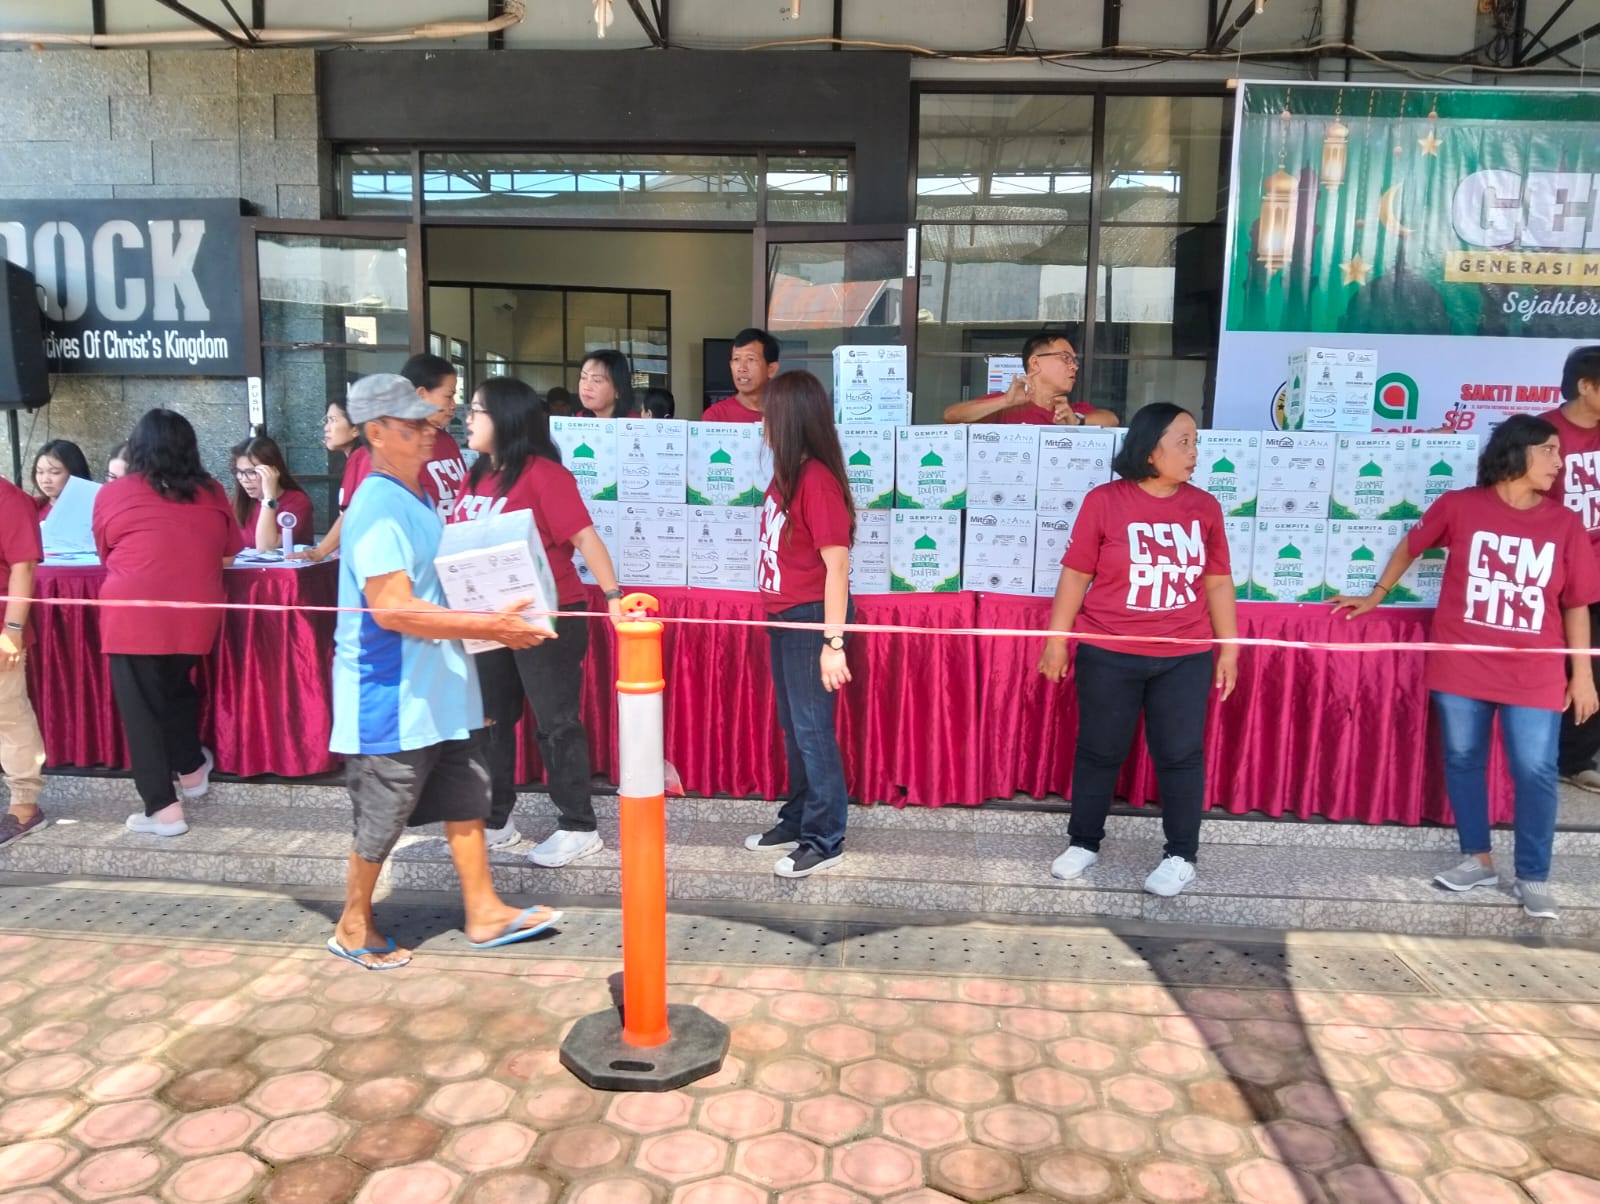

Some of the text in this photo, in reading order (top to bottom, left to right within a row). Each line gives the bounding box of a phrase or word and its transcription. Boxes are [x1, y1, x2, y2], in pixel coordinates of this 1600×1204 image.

[1452, 169, 1600, 248] GE
[1459, 259, 1572, 275] GENERASI
[1503, 291, 1600, 322] Sejahter
[83, 330, 101, 358] Of
[103, 329, 162, 358] Christ's
[164, 329, 228, 365] Kingdom
[1460, 384, 1513, 402] SAKTI
